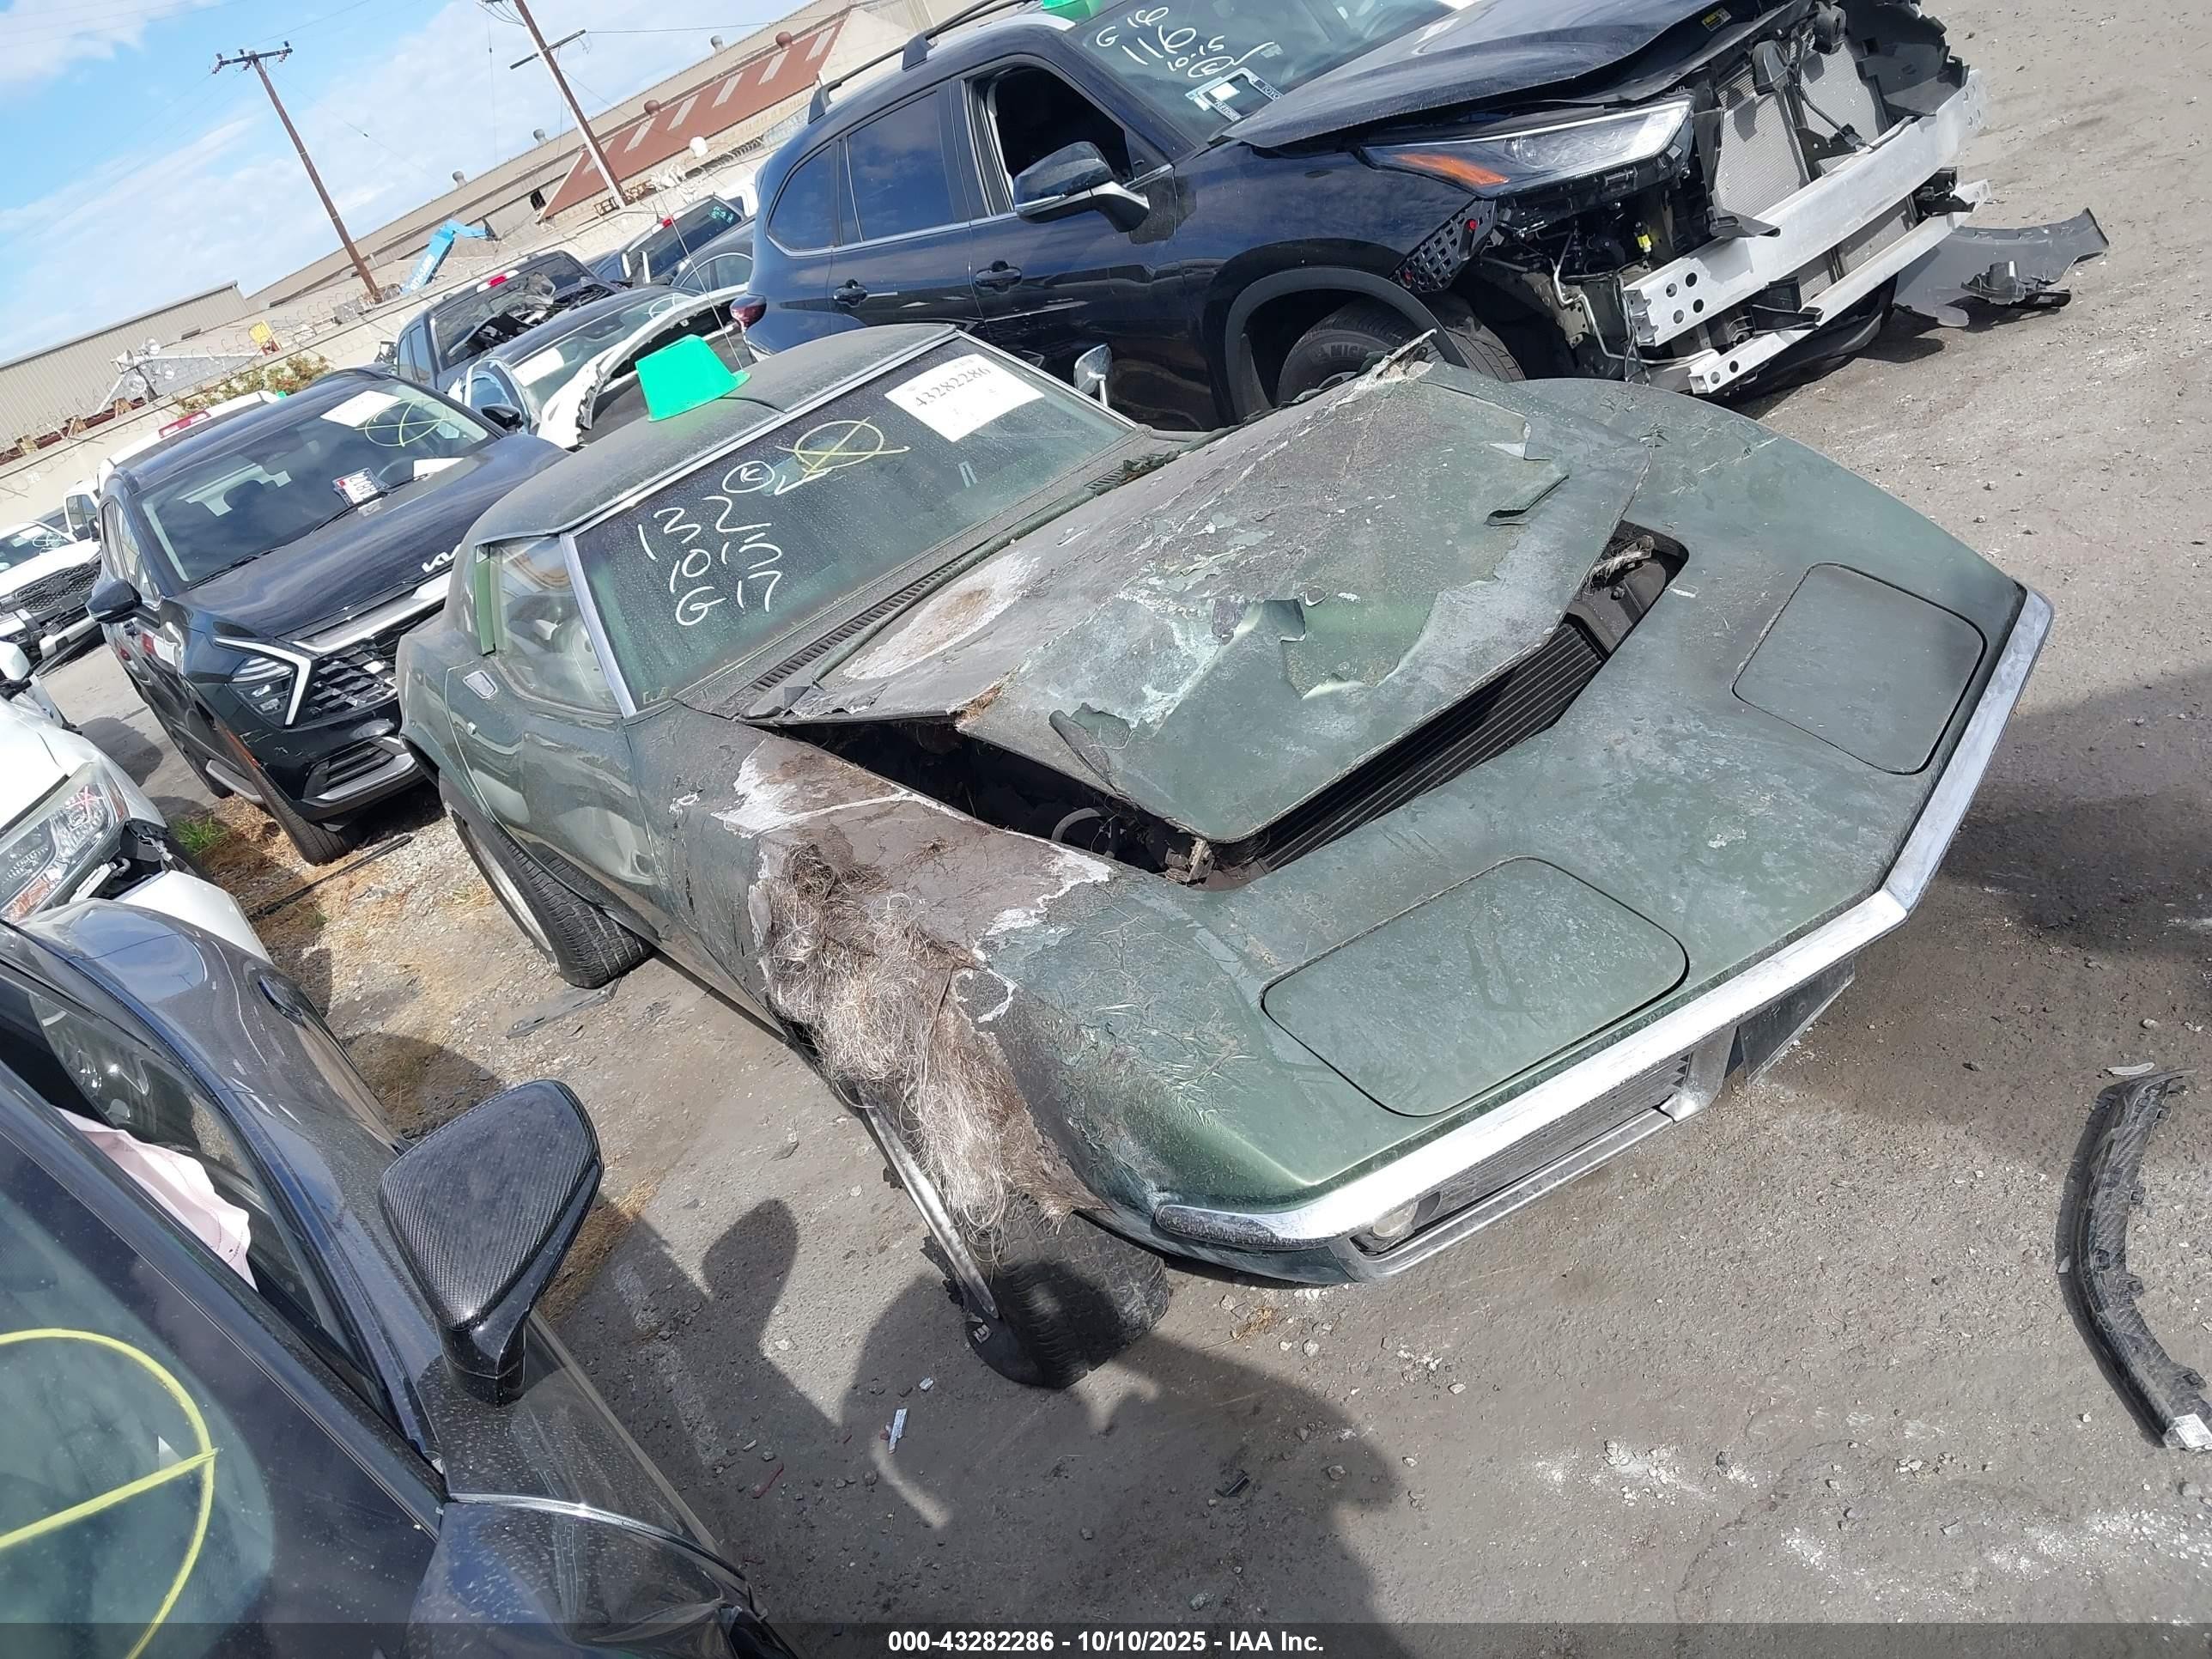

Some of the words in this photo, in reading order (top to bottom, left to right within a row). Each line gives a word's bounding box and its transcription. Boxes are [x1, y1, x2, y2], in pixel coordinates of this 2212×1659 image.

[1261, 83, 1282, 100] TOYO
[914, 367, 992, 408] 43282286
[637, 495, 773, 561] 132
